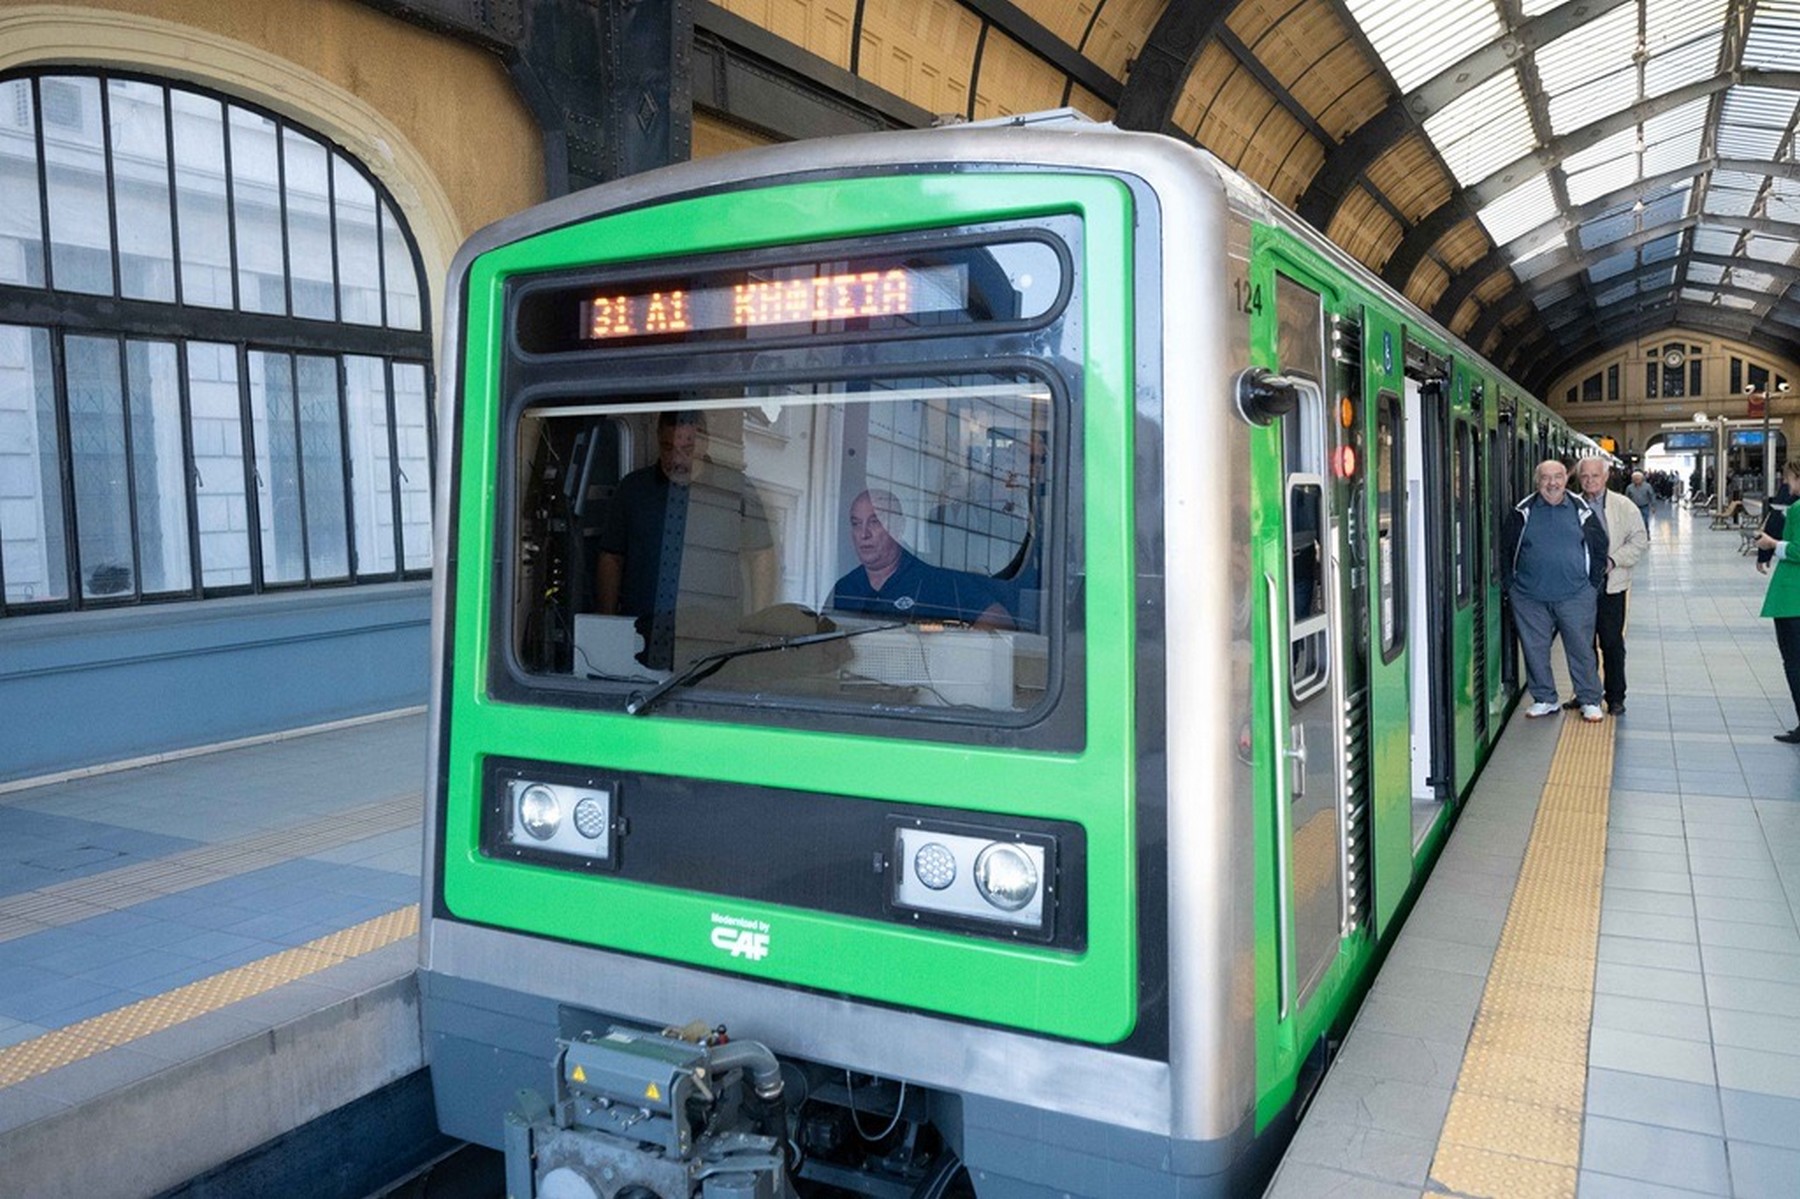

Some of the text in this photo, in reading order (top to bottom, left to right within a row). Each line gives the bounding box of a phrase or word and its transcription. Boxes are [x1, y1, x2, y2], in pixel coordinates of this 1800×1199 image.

[1233, 277, 1262, 316] 124
[711, 926, 770, 961] CAF
[759, 920, 770, 933] by
